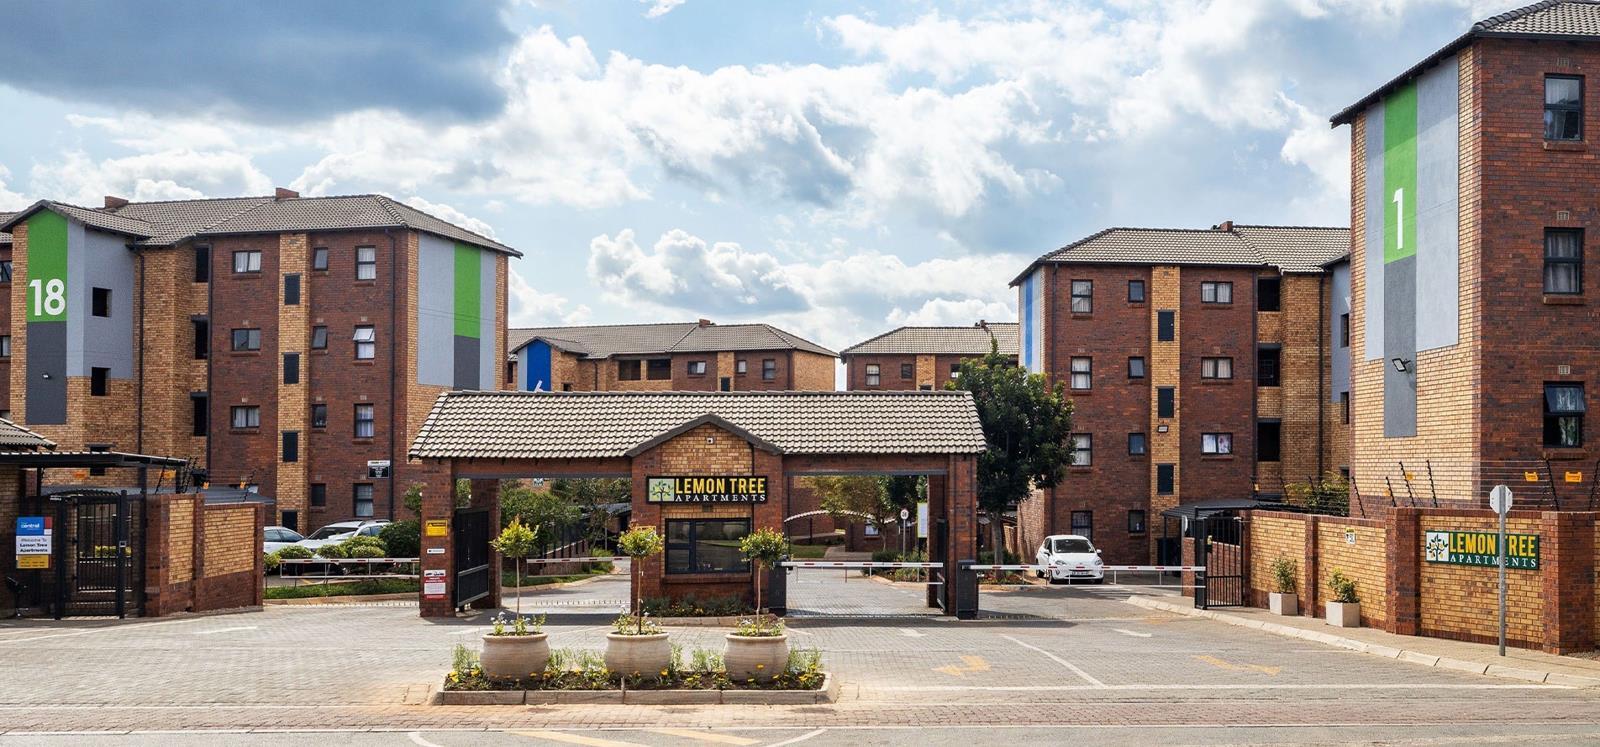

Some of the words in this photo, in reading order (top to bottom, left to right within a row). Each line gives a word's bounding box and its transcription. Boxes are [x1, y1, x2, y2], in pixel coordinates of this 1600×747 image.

[1392, 187, 1404, 250] 1
[29, 278, 66, 316] 18
[675, 478, 725, 494] LEMON
[729, 478, 766, 494] TREE
[675, 494, 766, 502] APARTMENTS
[1449, 533, 1496, 555] LEMON
[1503, 535, 1536, 557] REE
